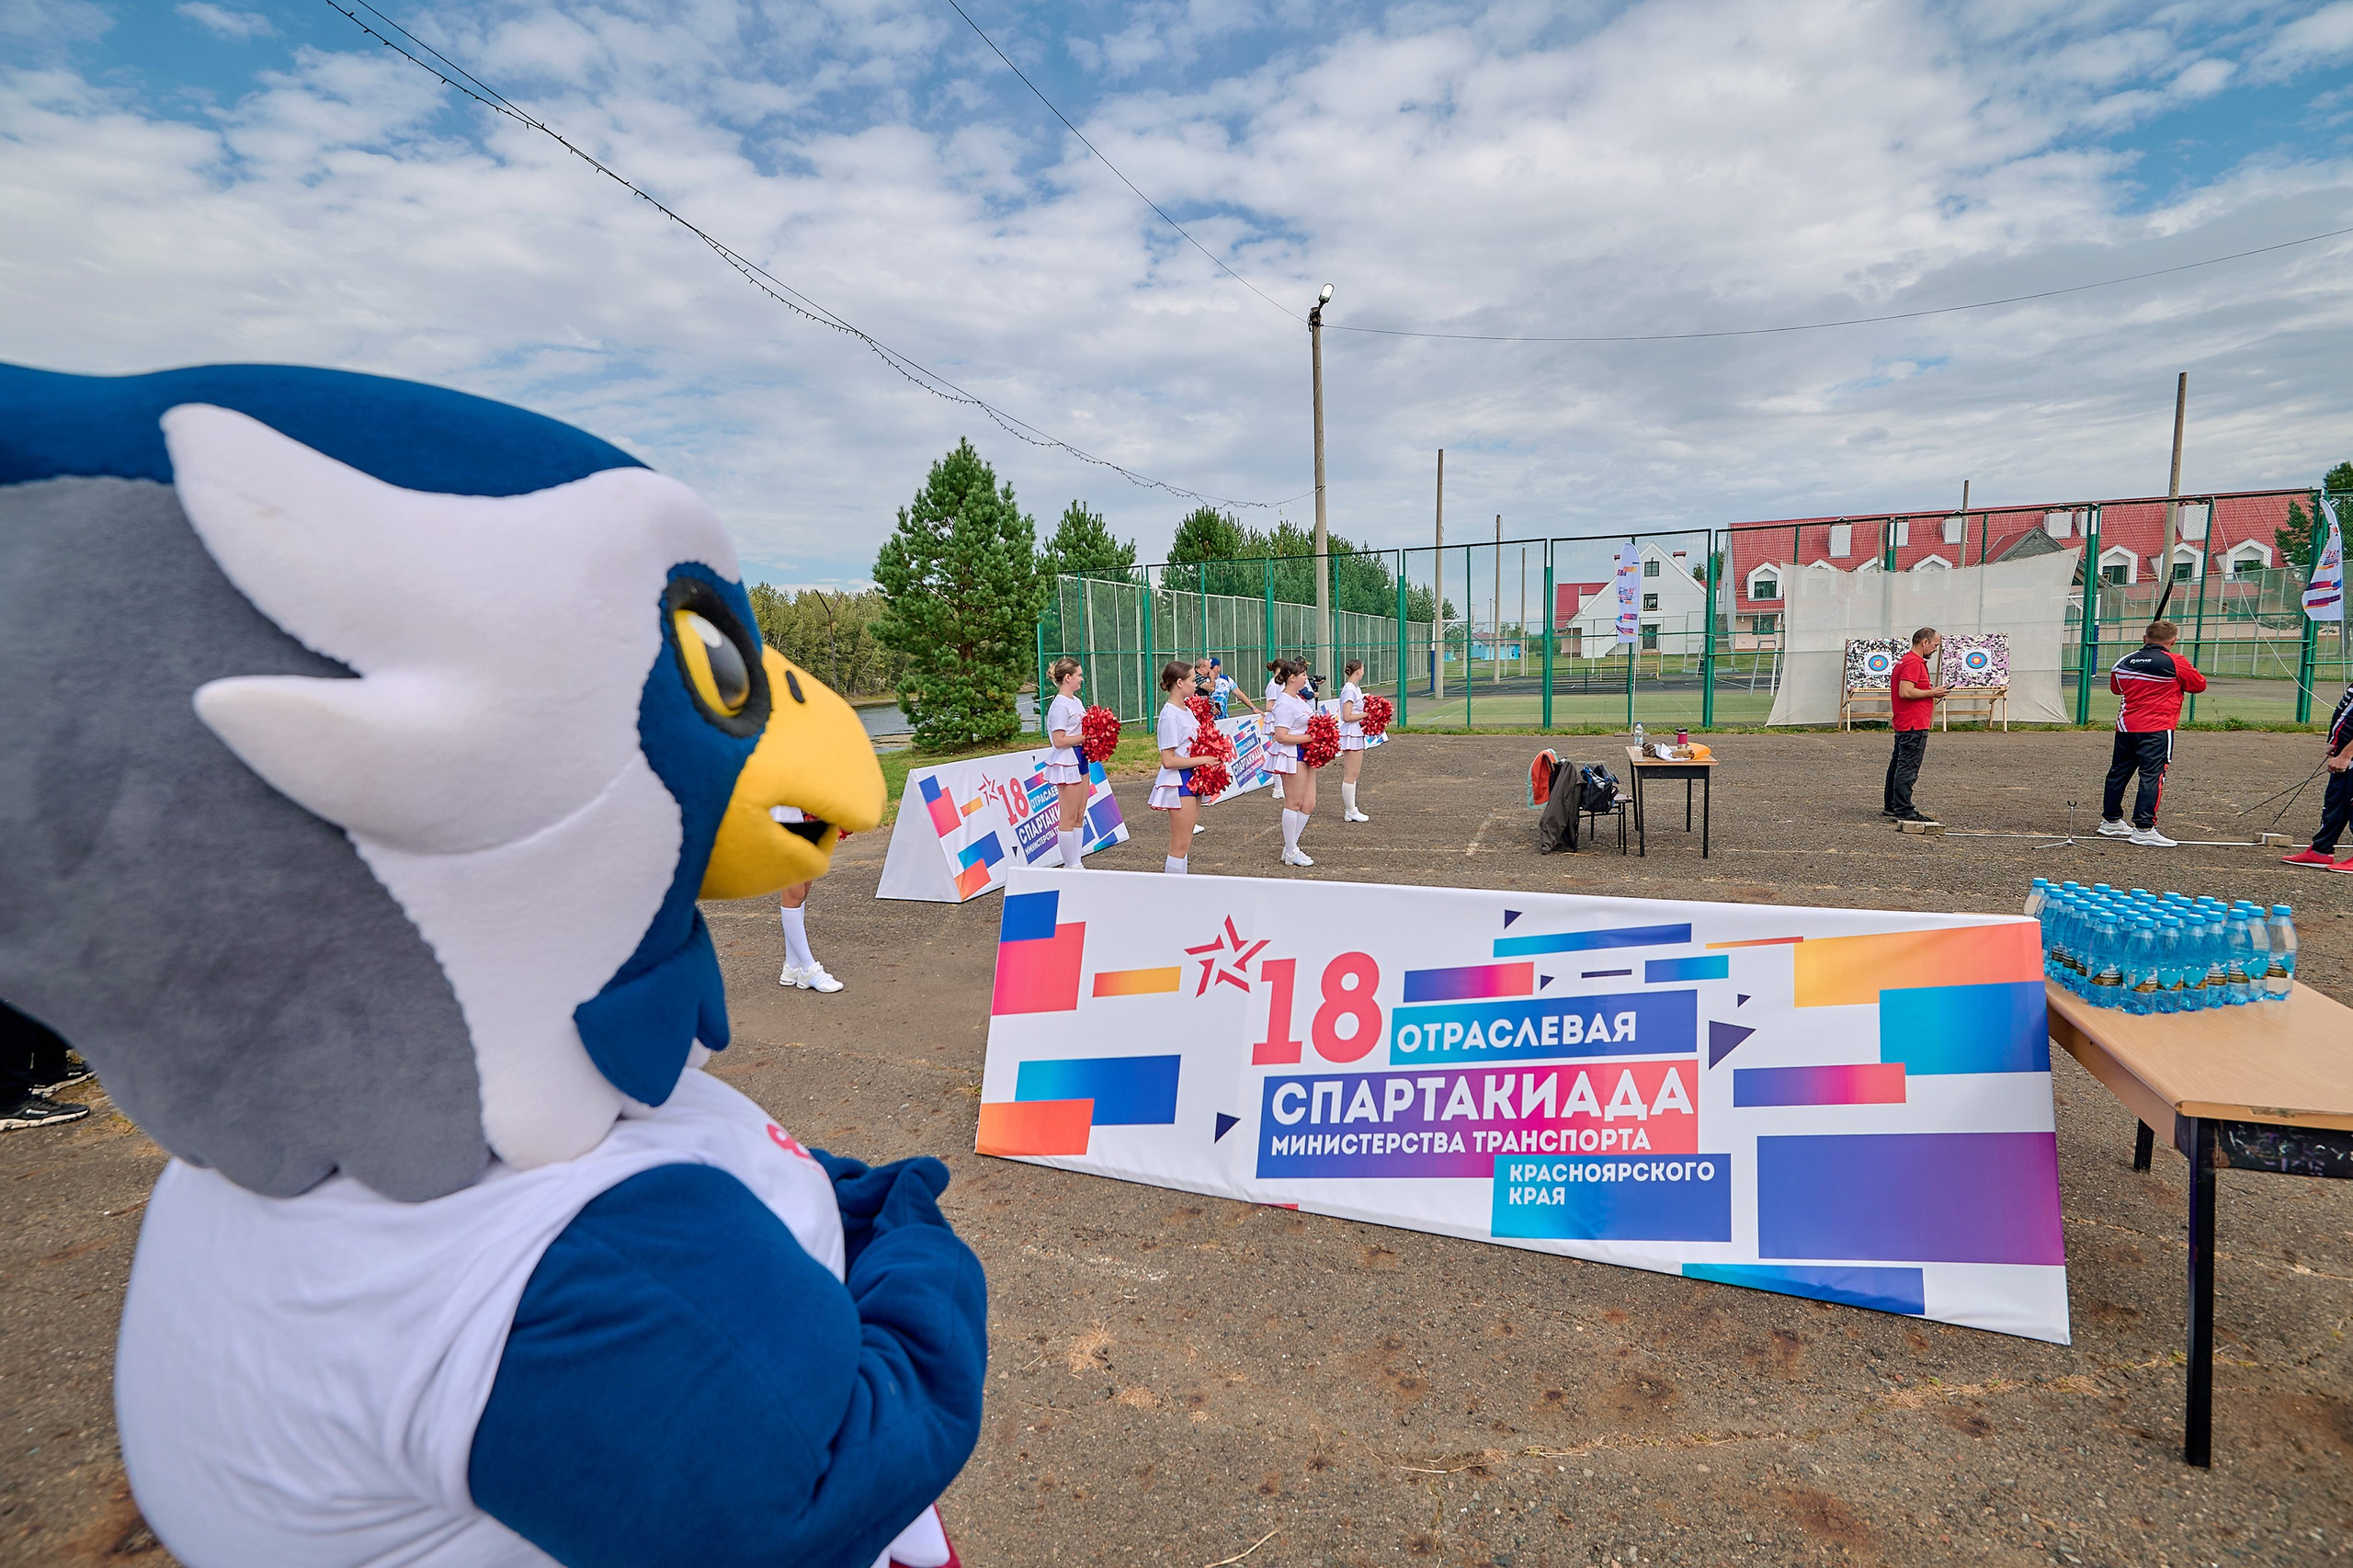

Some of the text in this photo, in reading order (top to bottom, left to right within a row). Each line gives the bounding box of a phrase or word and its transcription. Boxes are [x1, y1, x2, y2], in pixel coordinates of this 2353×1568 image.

[997, 778, 1029, 826] 18
[1029, 784, 1059, 809] ОТРАСЛЕВ
[1017, 804, 1060, 845] СПАРТАКИ
[1251, 951, 1382, 1066] 18
[1397, 1011, 1636, 1052] ОТРАСЛЕВАЯ
[1272, 1067, 1694, 1125] СПАРТАКИАДА
[1271, 1128, 1652, 1156] МИНИСТЕРСТВА ТРАНСПОРТА
[1509, 1162, 1715, 1182] КРАСНОЯРСКОГО
[1508, 1187, 1565, 1205] КРАЯ
